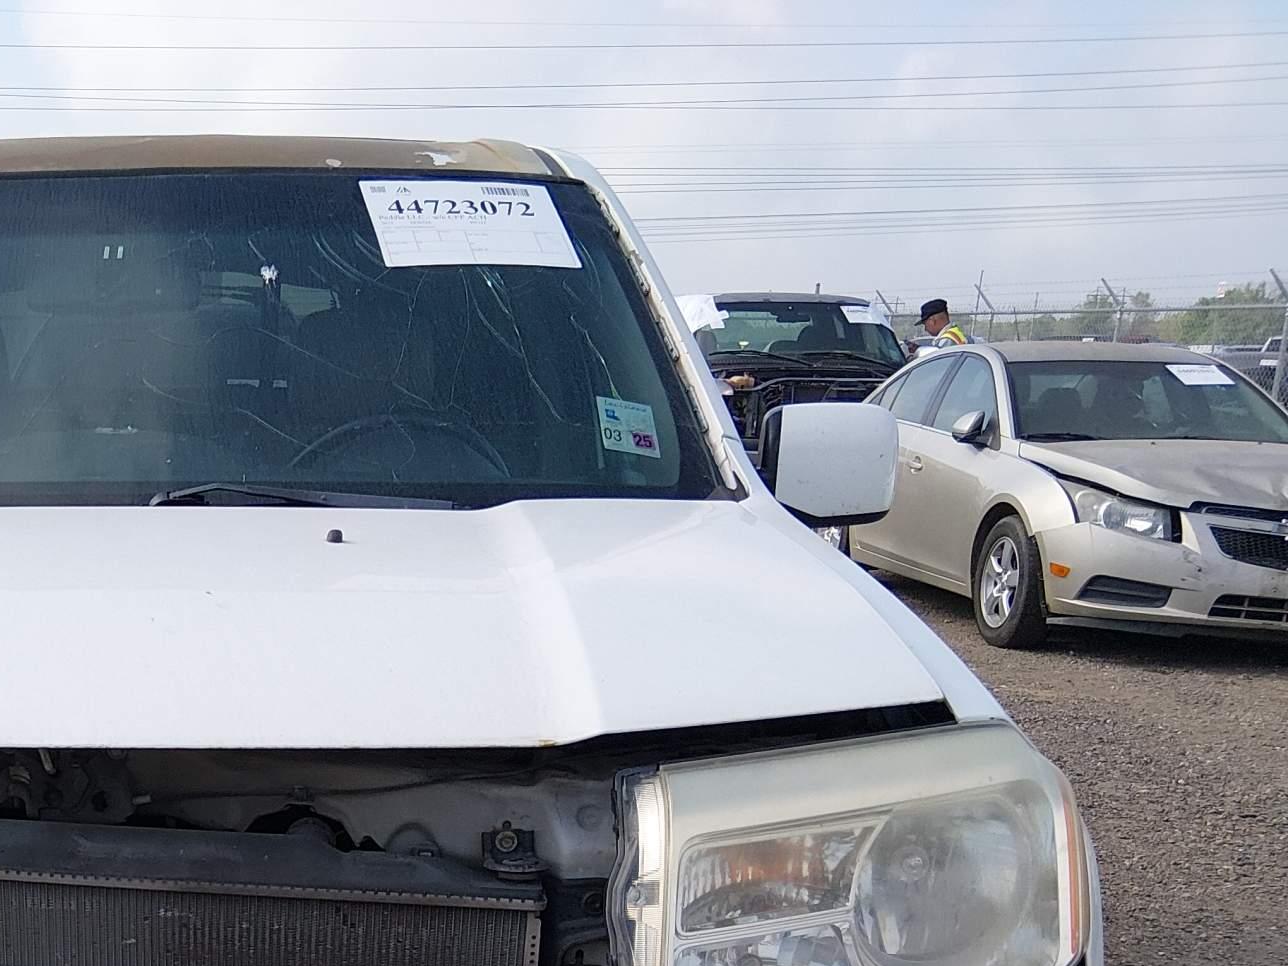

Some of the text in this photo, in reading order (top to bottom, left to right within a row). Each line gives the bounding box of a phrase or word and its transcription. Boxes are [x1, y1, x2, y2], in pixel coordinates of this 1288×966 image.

[387, 199, 535, 217] 44723072
[604, 427, 653, 448] 03 25
